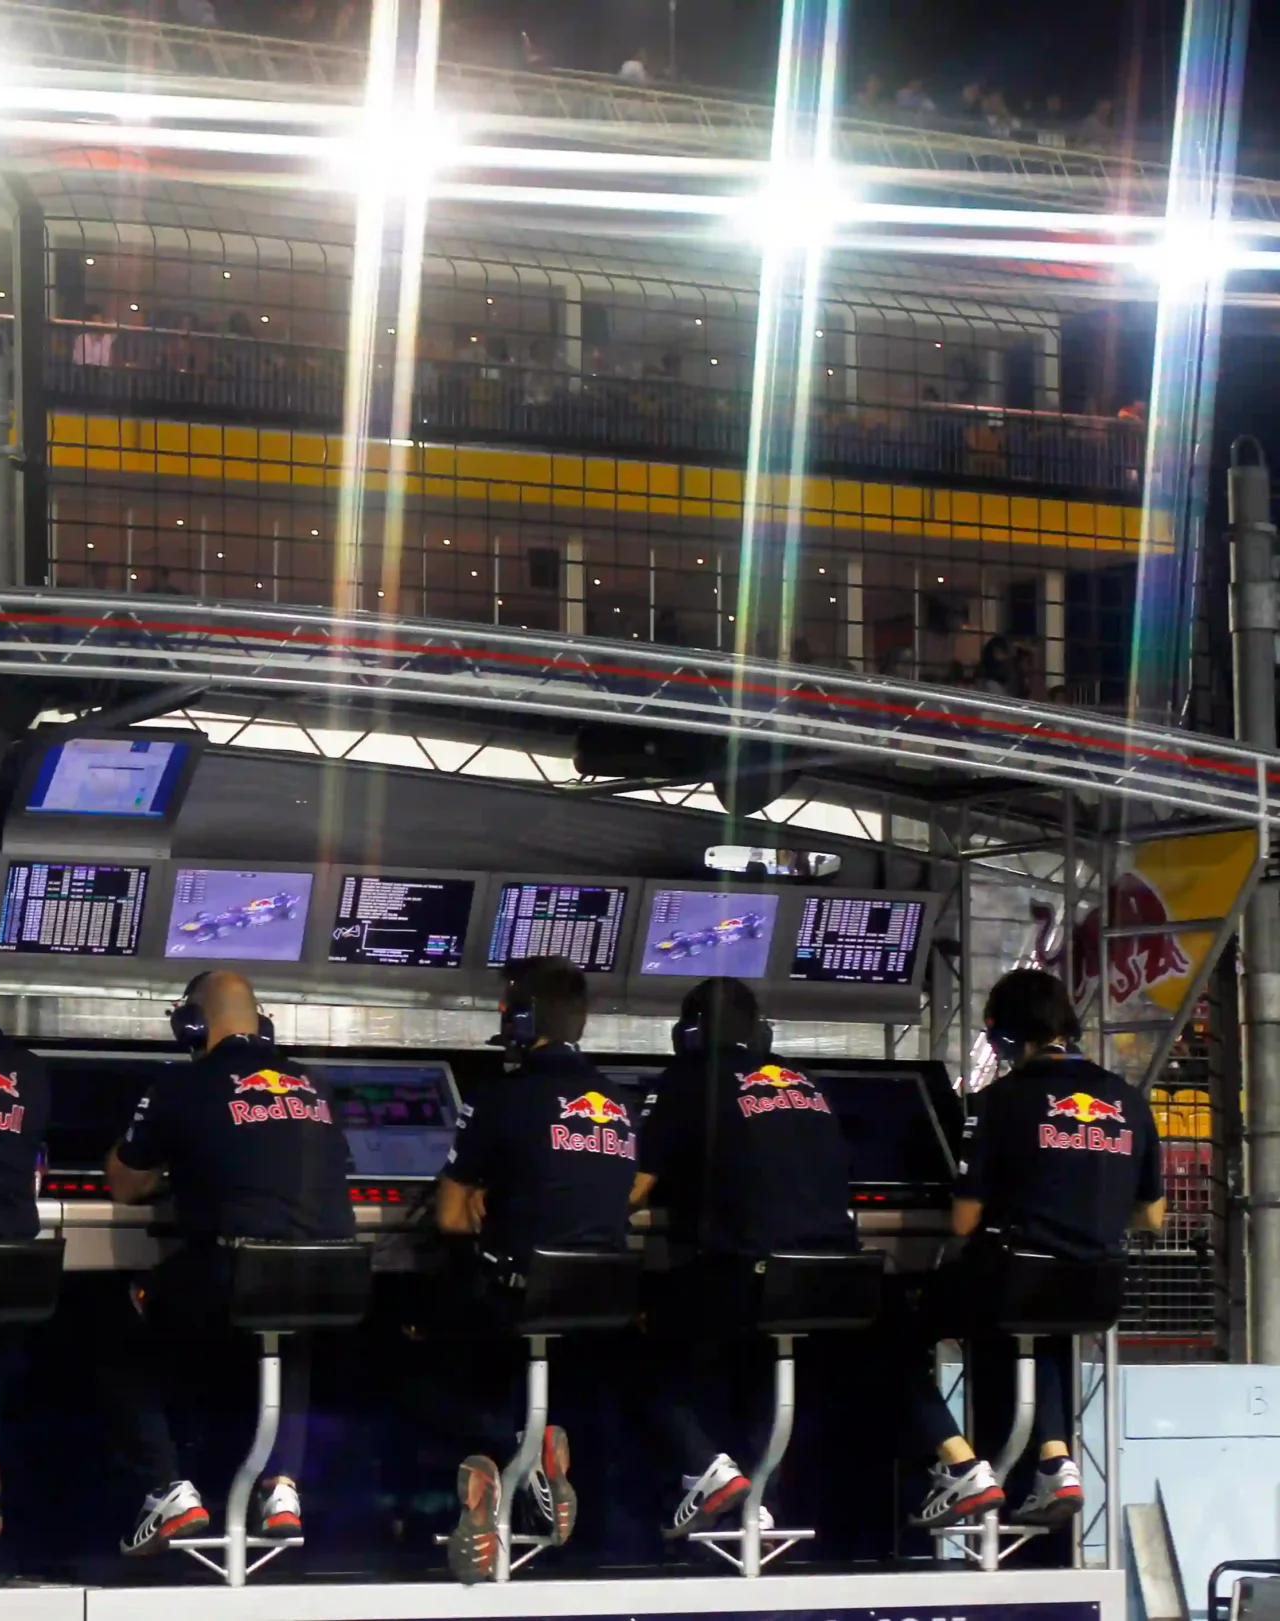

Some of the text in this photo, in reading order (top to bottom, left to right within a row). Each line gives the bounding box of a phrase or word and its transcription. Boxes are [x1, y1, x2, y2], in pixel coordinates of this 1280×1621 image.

[228, 1095, 332, 1125] Red Bull
[737, 1089, 831, 1117] Red Bull
[551, 1125, 636, 1160] Red Bull
[1039, 1124, 1133, 1155] Red Bull
